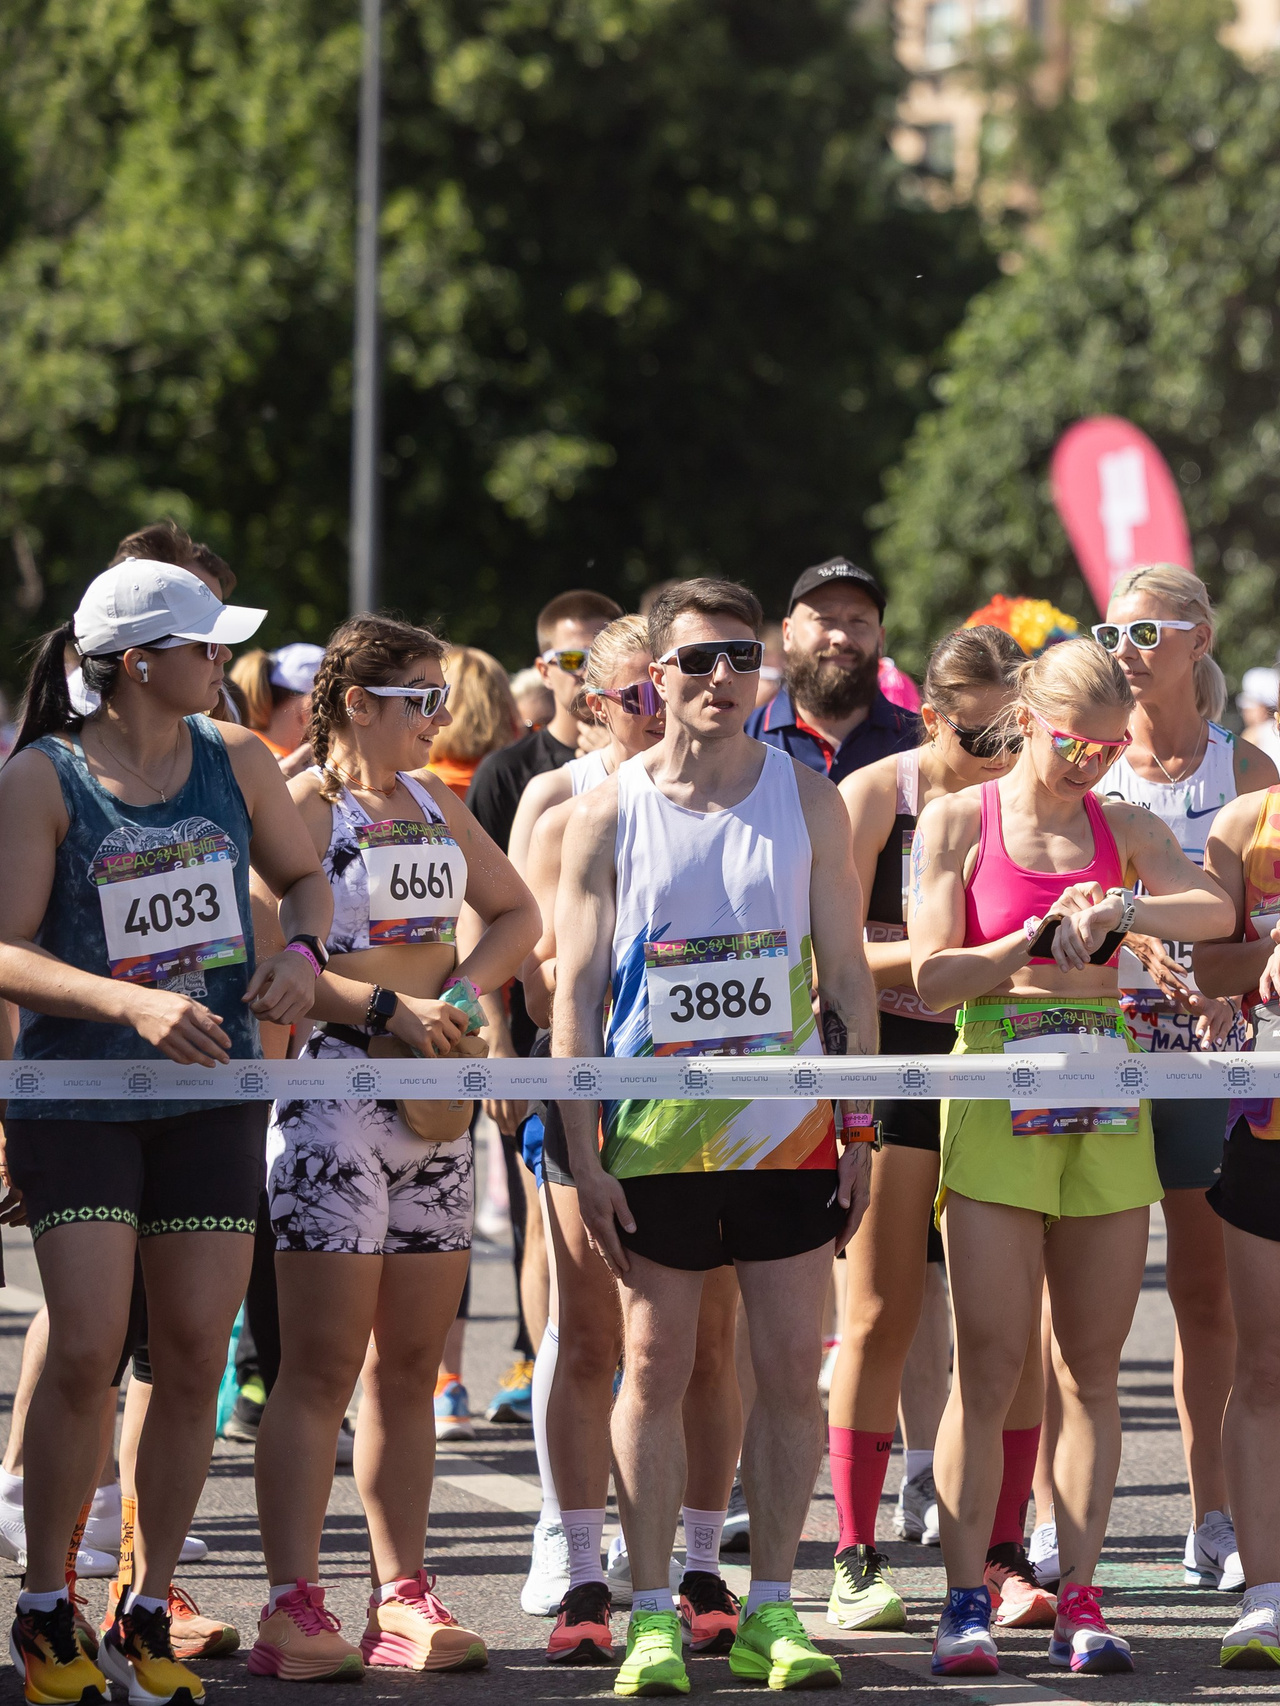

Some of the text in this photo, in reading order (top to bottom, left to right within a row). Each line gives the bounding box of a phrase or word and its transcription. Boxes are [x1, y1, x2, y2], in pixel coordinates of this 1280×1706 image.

[106, 838, 217, 874] КРАСОЧНЫЙ
[173, 851, 228, 871] 2026
[390, 862, 453, 900] 6661
[124, 883, 221, 937] 4033
[656, 931, 776, 957] КРАСОЧНЫЙ
[870, 927, 904, 943] PR
[726, 948, 786, 962] 2026
[669, 977, 771, 1022] 3886
